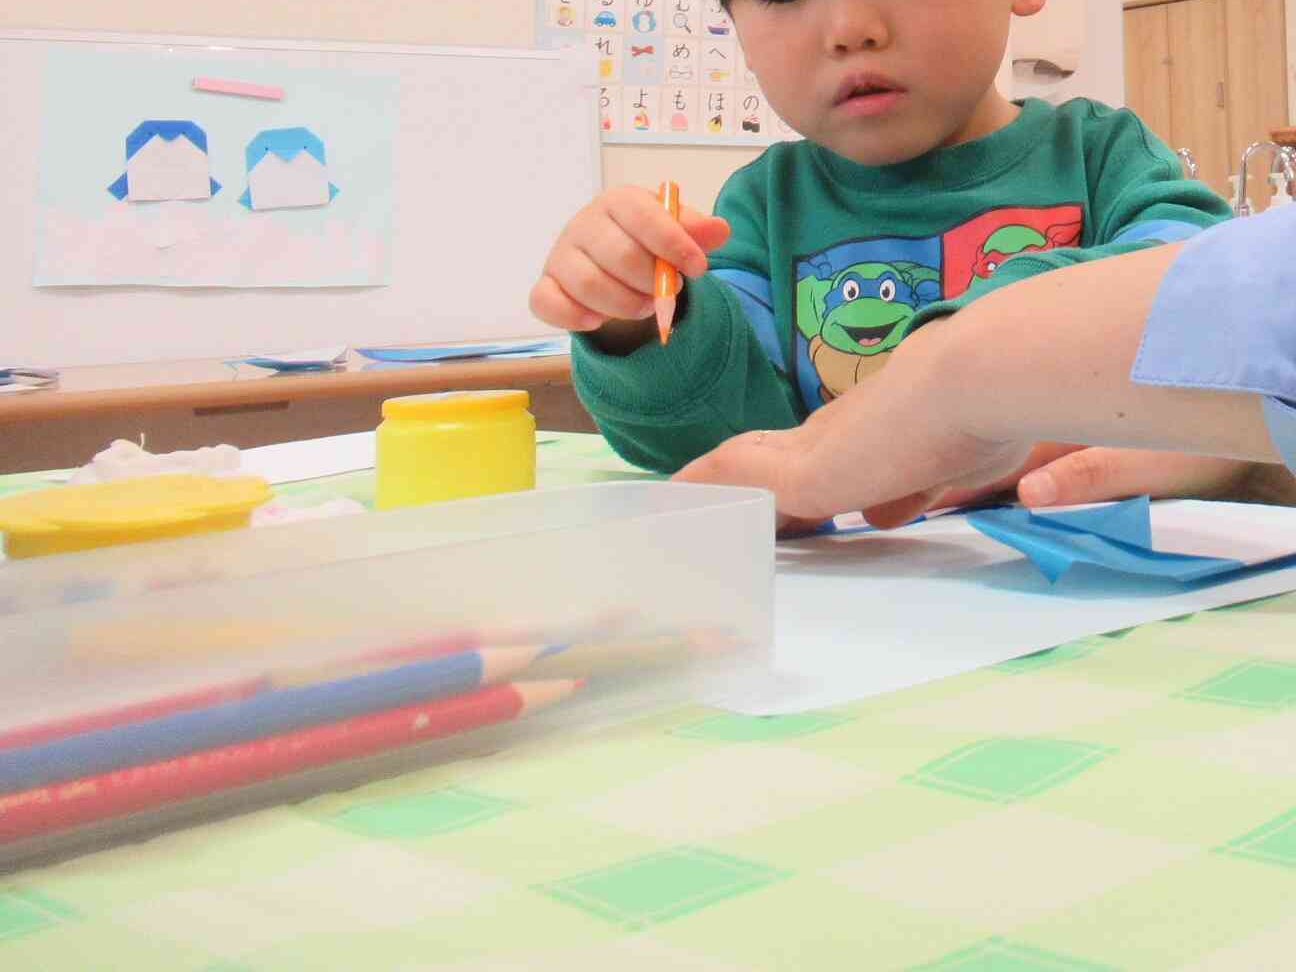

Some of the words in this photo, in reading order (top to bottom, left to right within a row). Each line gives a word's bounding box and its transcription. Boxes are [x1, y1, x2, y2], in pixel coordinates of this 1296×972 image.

[595, 36, 614, 56] れ
[672, 43, 691, 59] め
[708, 46, 727, 60] へ
[633, 87, 649, 109] よ
[672, 89, 687, 111] も
[708, 92, 726, 111] ほ
[743, 94, 761, 111] の
